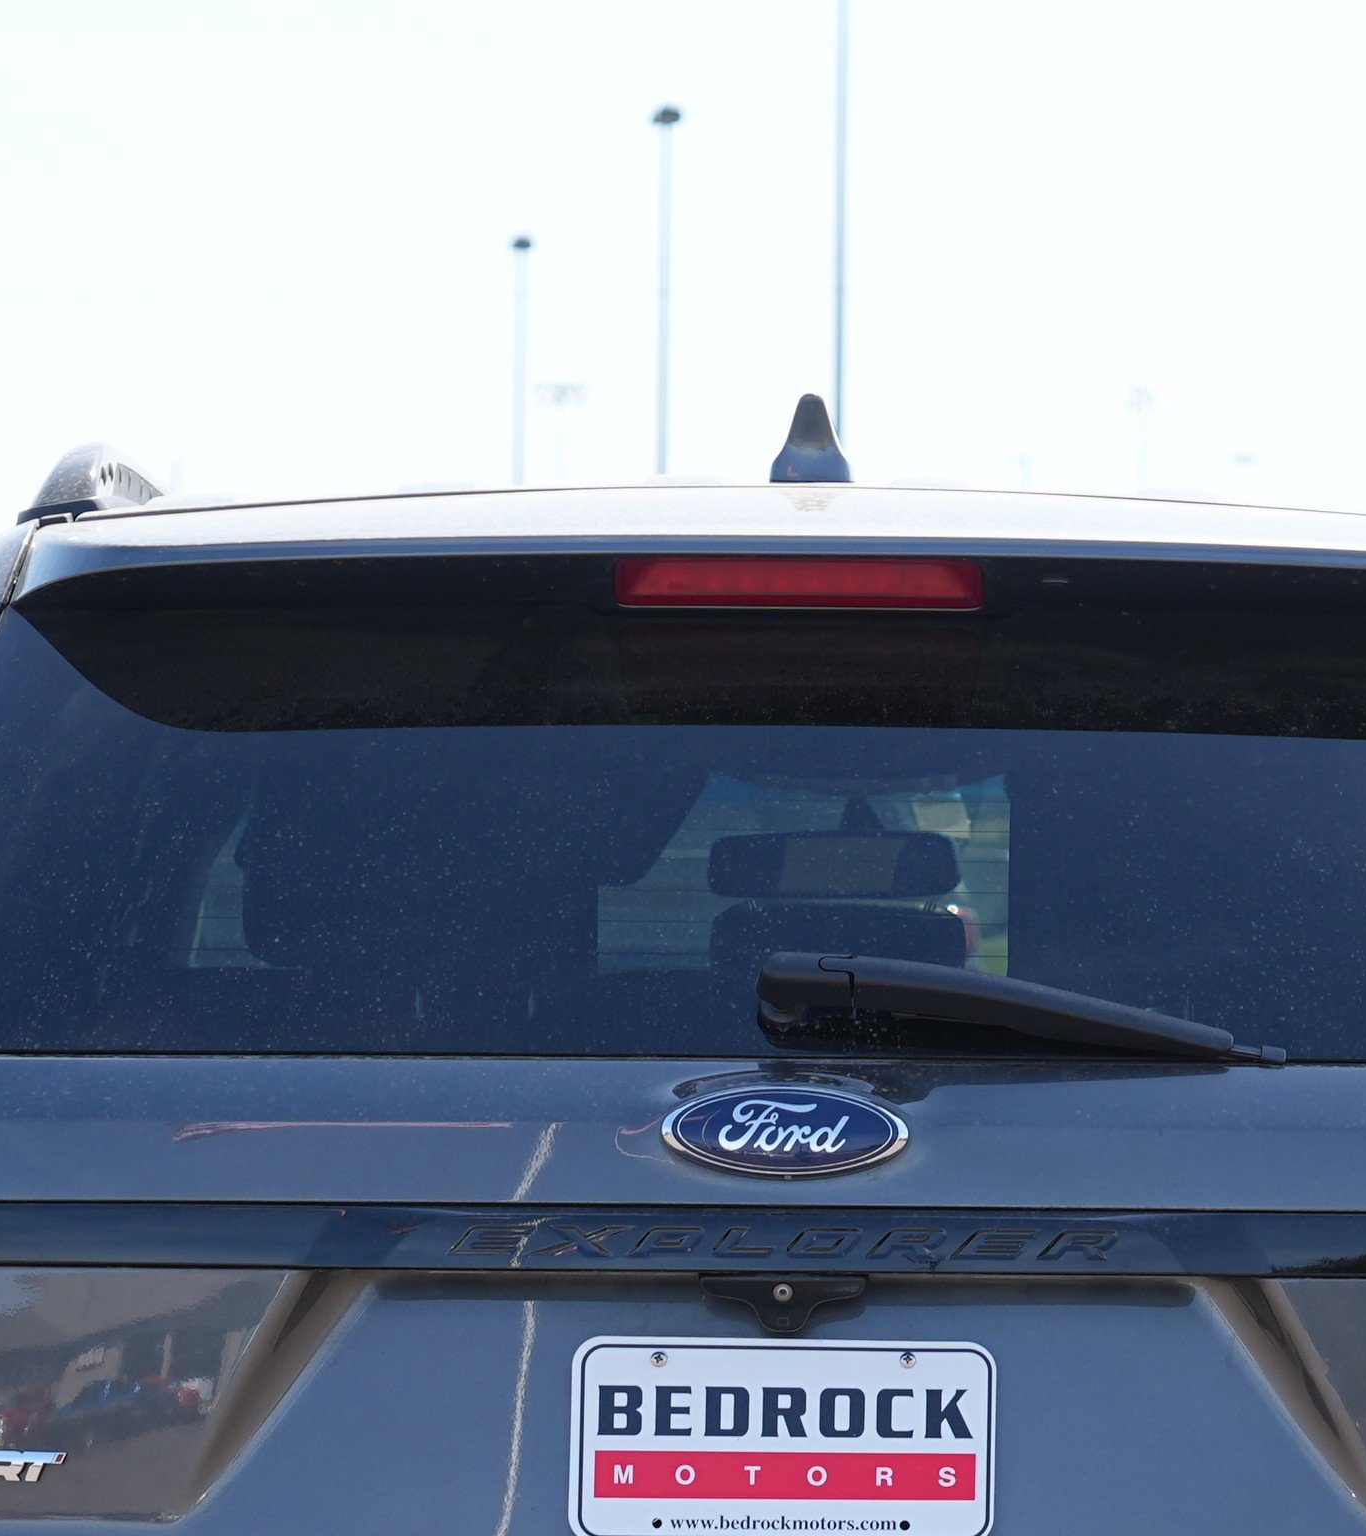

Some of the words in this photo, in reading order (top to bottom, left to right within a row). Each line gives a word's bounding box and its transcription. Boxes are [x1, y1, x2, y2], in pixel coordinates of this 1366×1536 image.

[718, 1098, 848, 1154] Ford
[446, 1224, 1119, 1262] EXPLORER
[597, 1384, 974, 1440] BEDROCK
[613, 1464, 957, 1487] MOTORS
[669, 1515, 897, 1532] www.bedrockmotors.com
